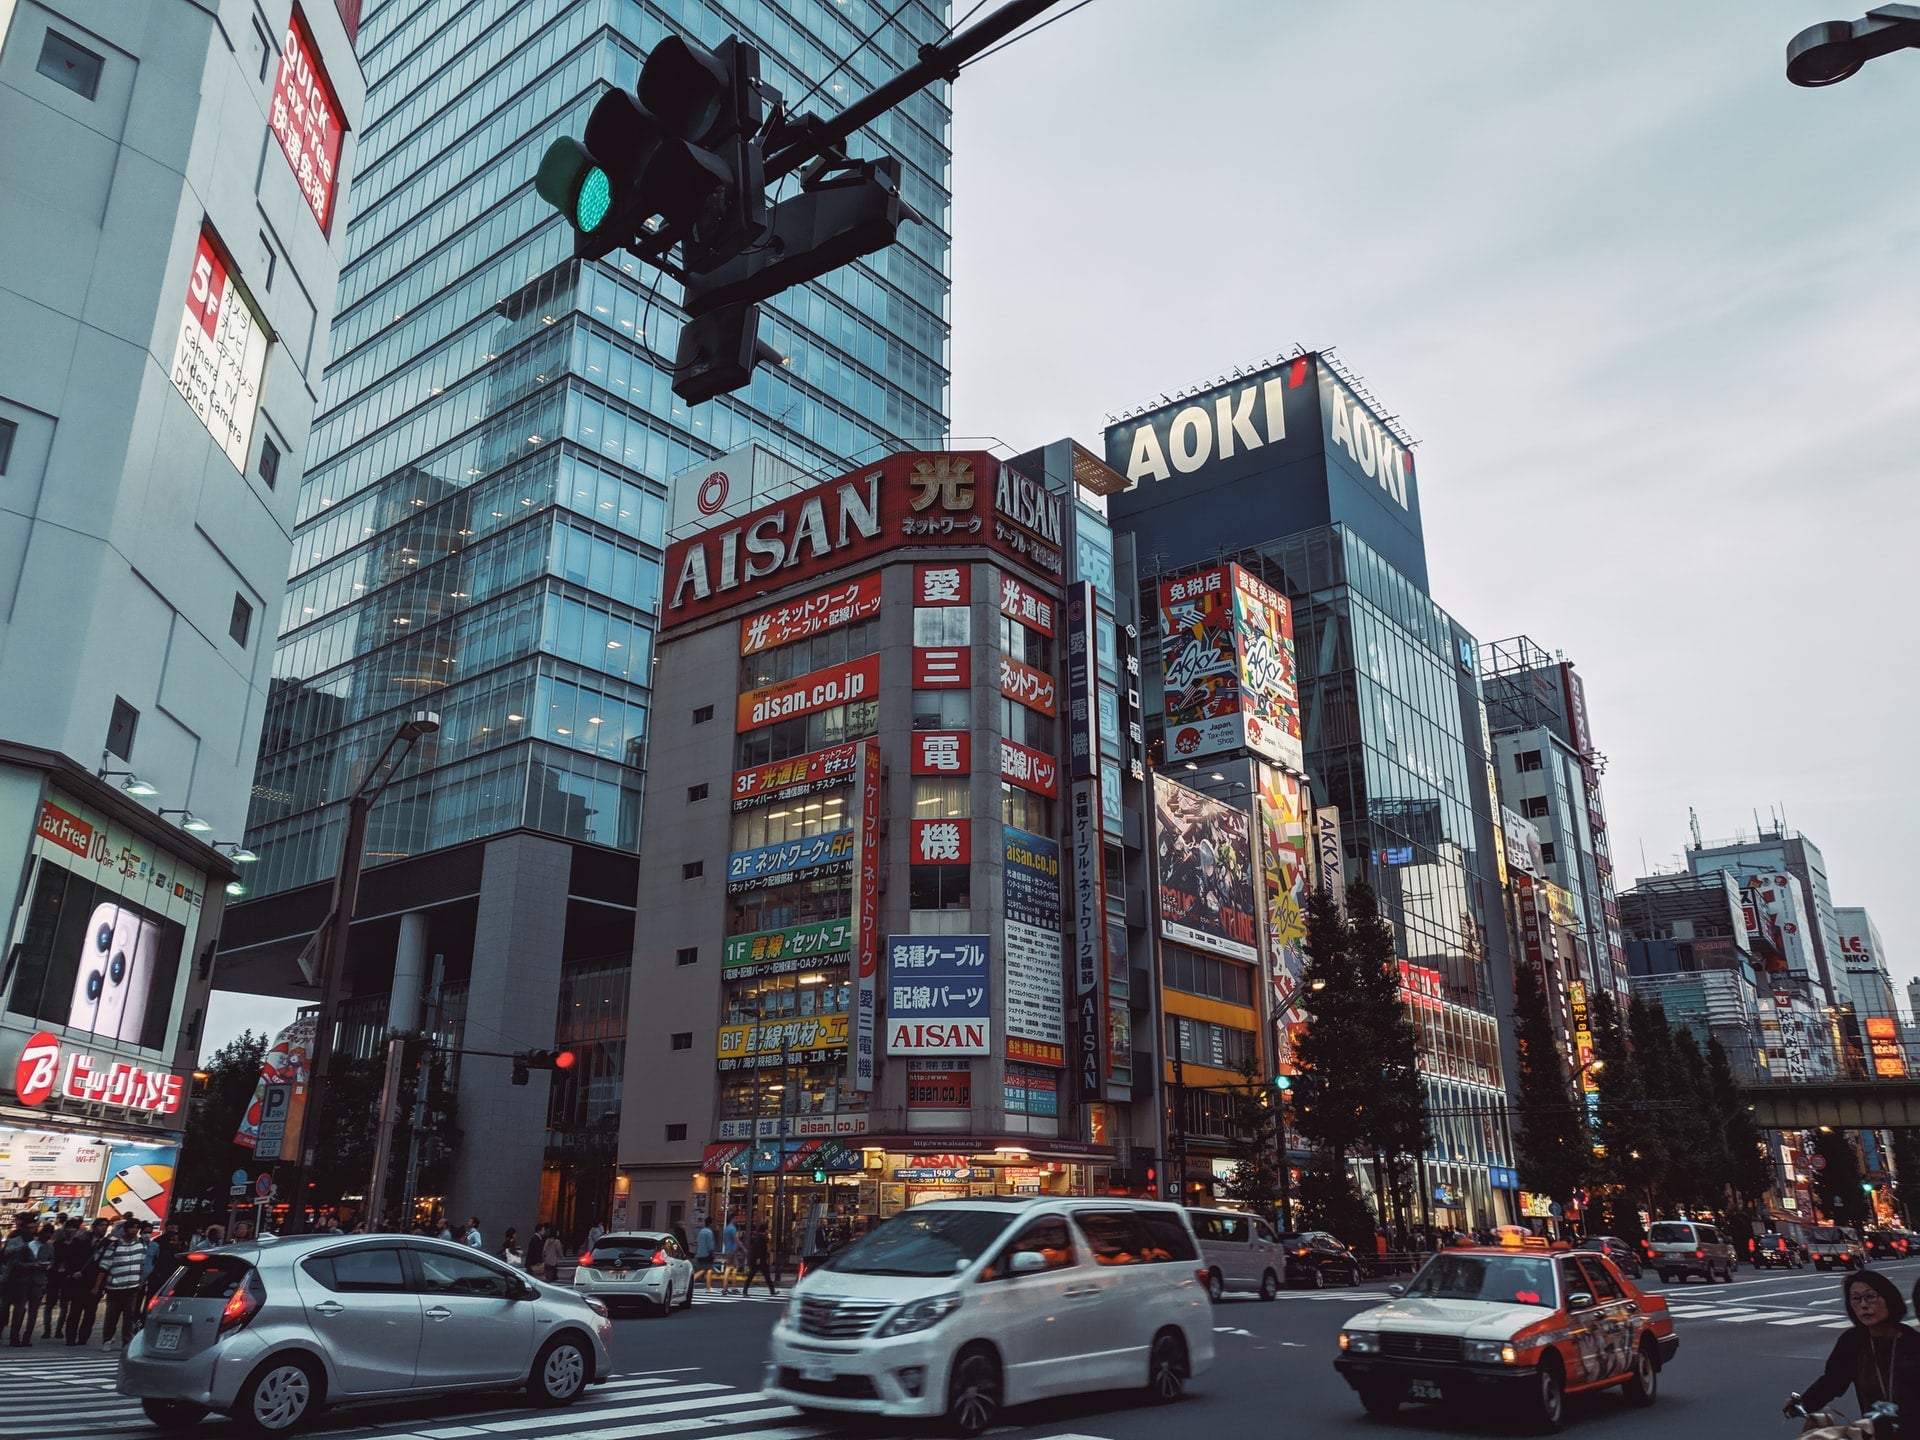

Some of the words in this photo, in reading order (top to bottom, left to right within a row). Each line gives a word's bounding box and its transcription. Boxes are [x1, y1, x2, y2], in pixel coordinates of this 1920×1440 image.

[285, 29, 330, 139] QUICK
[280, 54, 304, 124] Tax
[304, 109, 332, 183] Free
[191, 253, 218, 316] 5F
[184, 325, 218, 382] Camera
[224, 380, 237, 406] TV
[175, 367, 204, 417] Drone
[180, 345, 208, 397] Video
[209, 389, 242, 443] Camera
[1123, 376, 1286, 493] AOKI
[1331, 384, 1408, 512] AOKI
[909, 455, 975, 513] 光
[995, 463, 1062, 546] AISAN
[669, 470, 884, 610] AISAN
[901, 515, 982, 536] ネットワーク
[1002, 580, 1051, 629] 光通信
[1169, 572, 1222, 602] 免税店
[753, 670, 865, 723] aisan.co.jp
[1000, 660, 1055, 707] ネットワーク
[1207, 729, 1234, 740] Tax-free
[1571, 677, 1588, 751] カラオケ
[819, 747, 853, 761] ネットワーク
[1001, 742, 1055, 788] 配線パーツ
[1217, 738, 1235, 746] Shop
[737, 774, 756, 792] 3F
[59, 819, 87, 850] Free
[102, 857, 115, 869] OFF
[731, 856, 752, 876] 2F
[1006, 843, 1057, 876] aisan.co.jp
[1320, 816, 1340, 875] AKKY
[727, 941, 747, 960] 1F
[893, 945, 984, 968] 各種ケーブル
[893, 986, 984, 1010] 配線パーツ
[721, 1031, 743, 1051] B1F
[858, 989, 873, 1079] 愛三電機
[891, 1025, 984, 1047] AISAN
[1081, 997, 1097, 1090] AISAN
[63, 1052, 184, 1114] ビックカメラ
[265, 1089, 285, 1117] P
[909, 1082, 969, 1105] aisan.co.jp
[77, 1147, 96, 1155] Free
[722, 1122, 735, 1137] 各社
[759, 1120, 773, 1135] 在庫
[75, 1156, 97, 1164] Wi-Fi
[909, 1153, 968, 1169] AISAN
[933, 1169, 951, 1178] 1949
